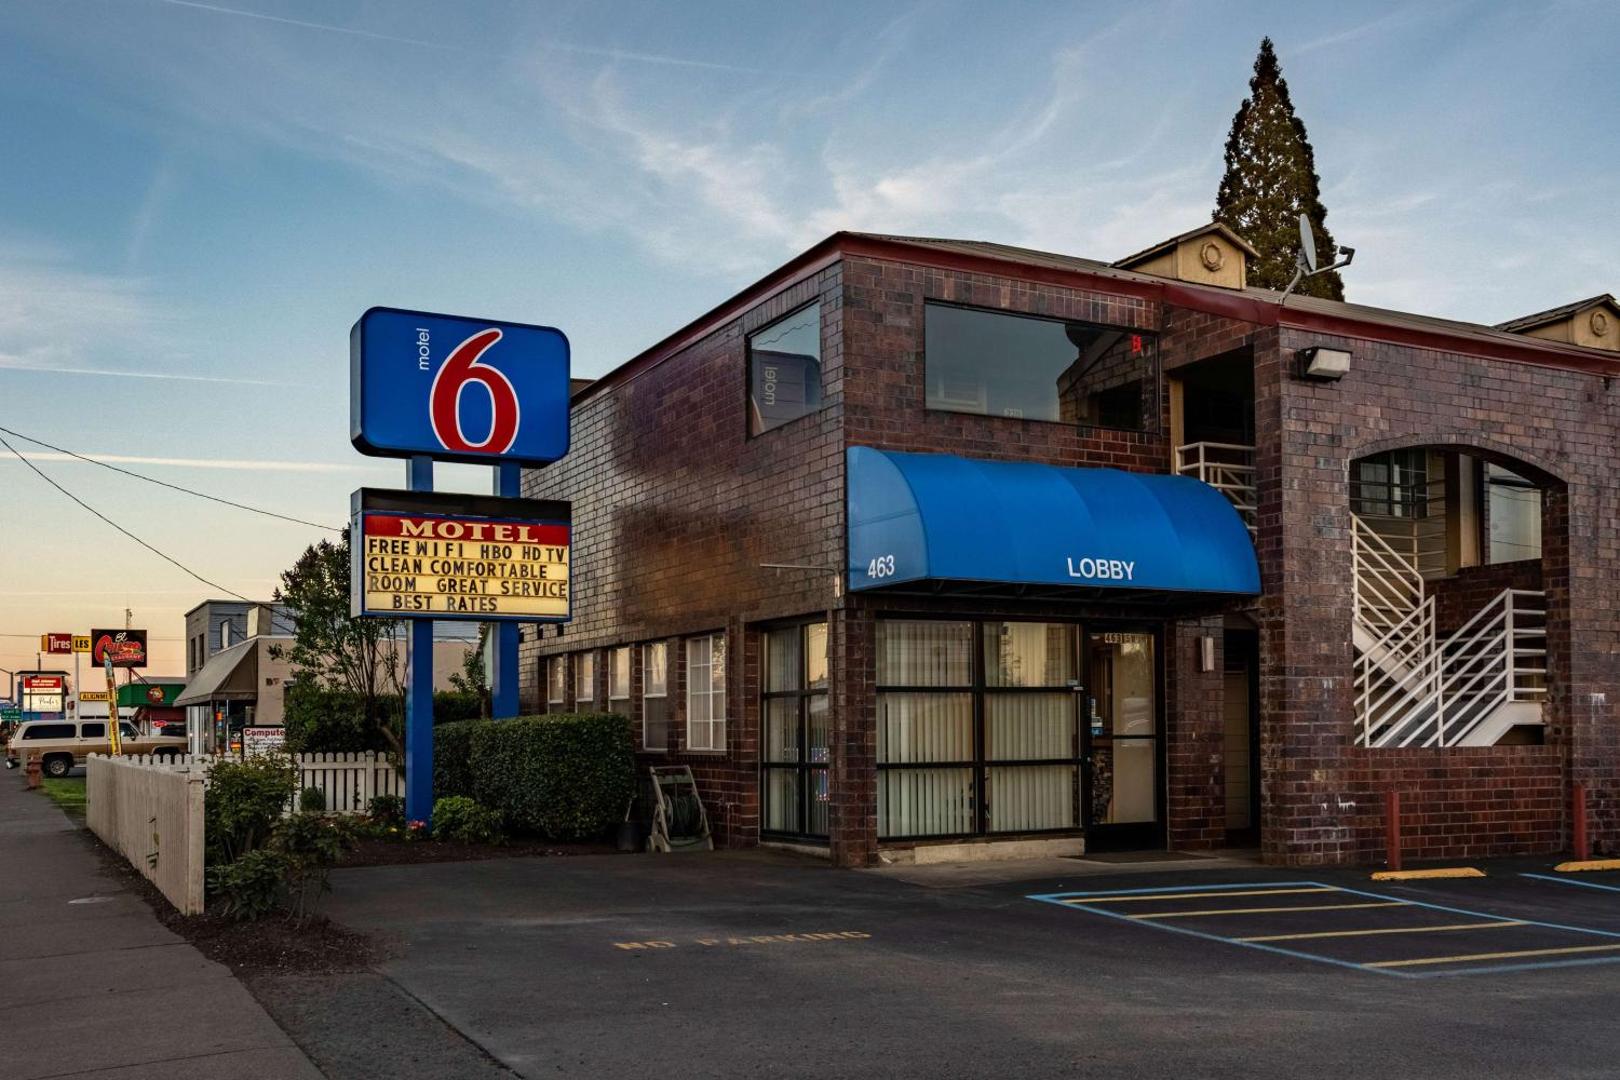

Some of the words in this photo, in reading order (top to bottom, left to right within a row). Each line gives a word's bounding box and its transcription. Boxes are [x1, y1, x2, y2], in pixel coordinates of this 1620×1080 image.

[416, 327, 430, 371] motel
[429, 328, 520, 454] 6
[400, 519, 539, 543] MOTEL
[368, 538, 410, 556] FREE
[480, 544, 513, 561] HBO
[368, 556, 422, 574] CLEAN
[430, 560, 548, 579] COMFORTABLE
[867, 555, 895, 579] 463
[1067, 557, 1135, 581] LOBBY
[368, 575, 417, 592] ROOM
[437, 578, 489, 594] GREAT
[500, 580, 567, 597] SERVICE
[393, 594, 433, 610] BEST
[447, 596, 498, 611] RATES
[49, 635, 71, 652] Tires
[75, 639, 89, 649] LES
[244, 729, 286, 738] Compute
